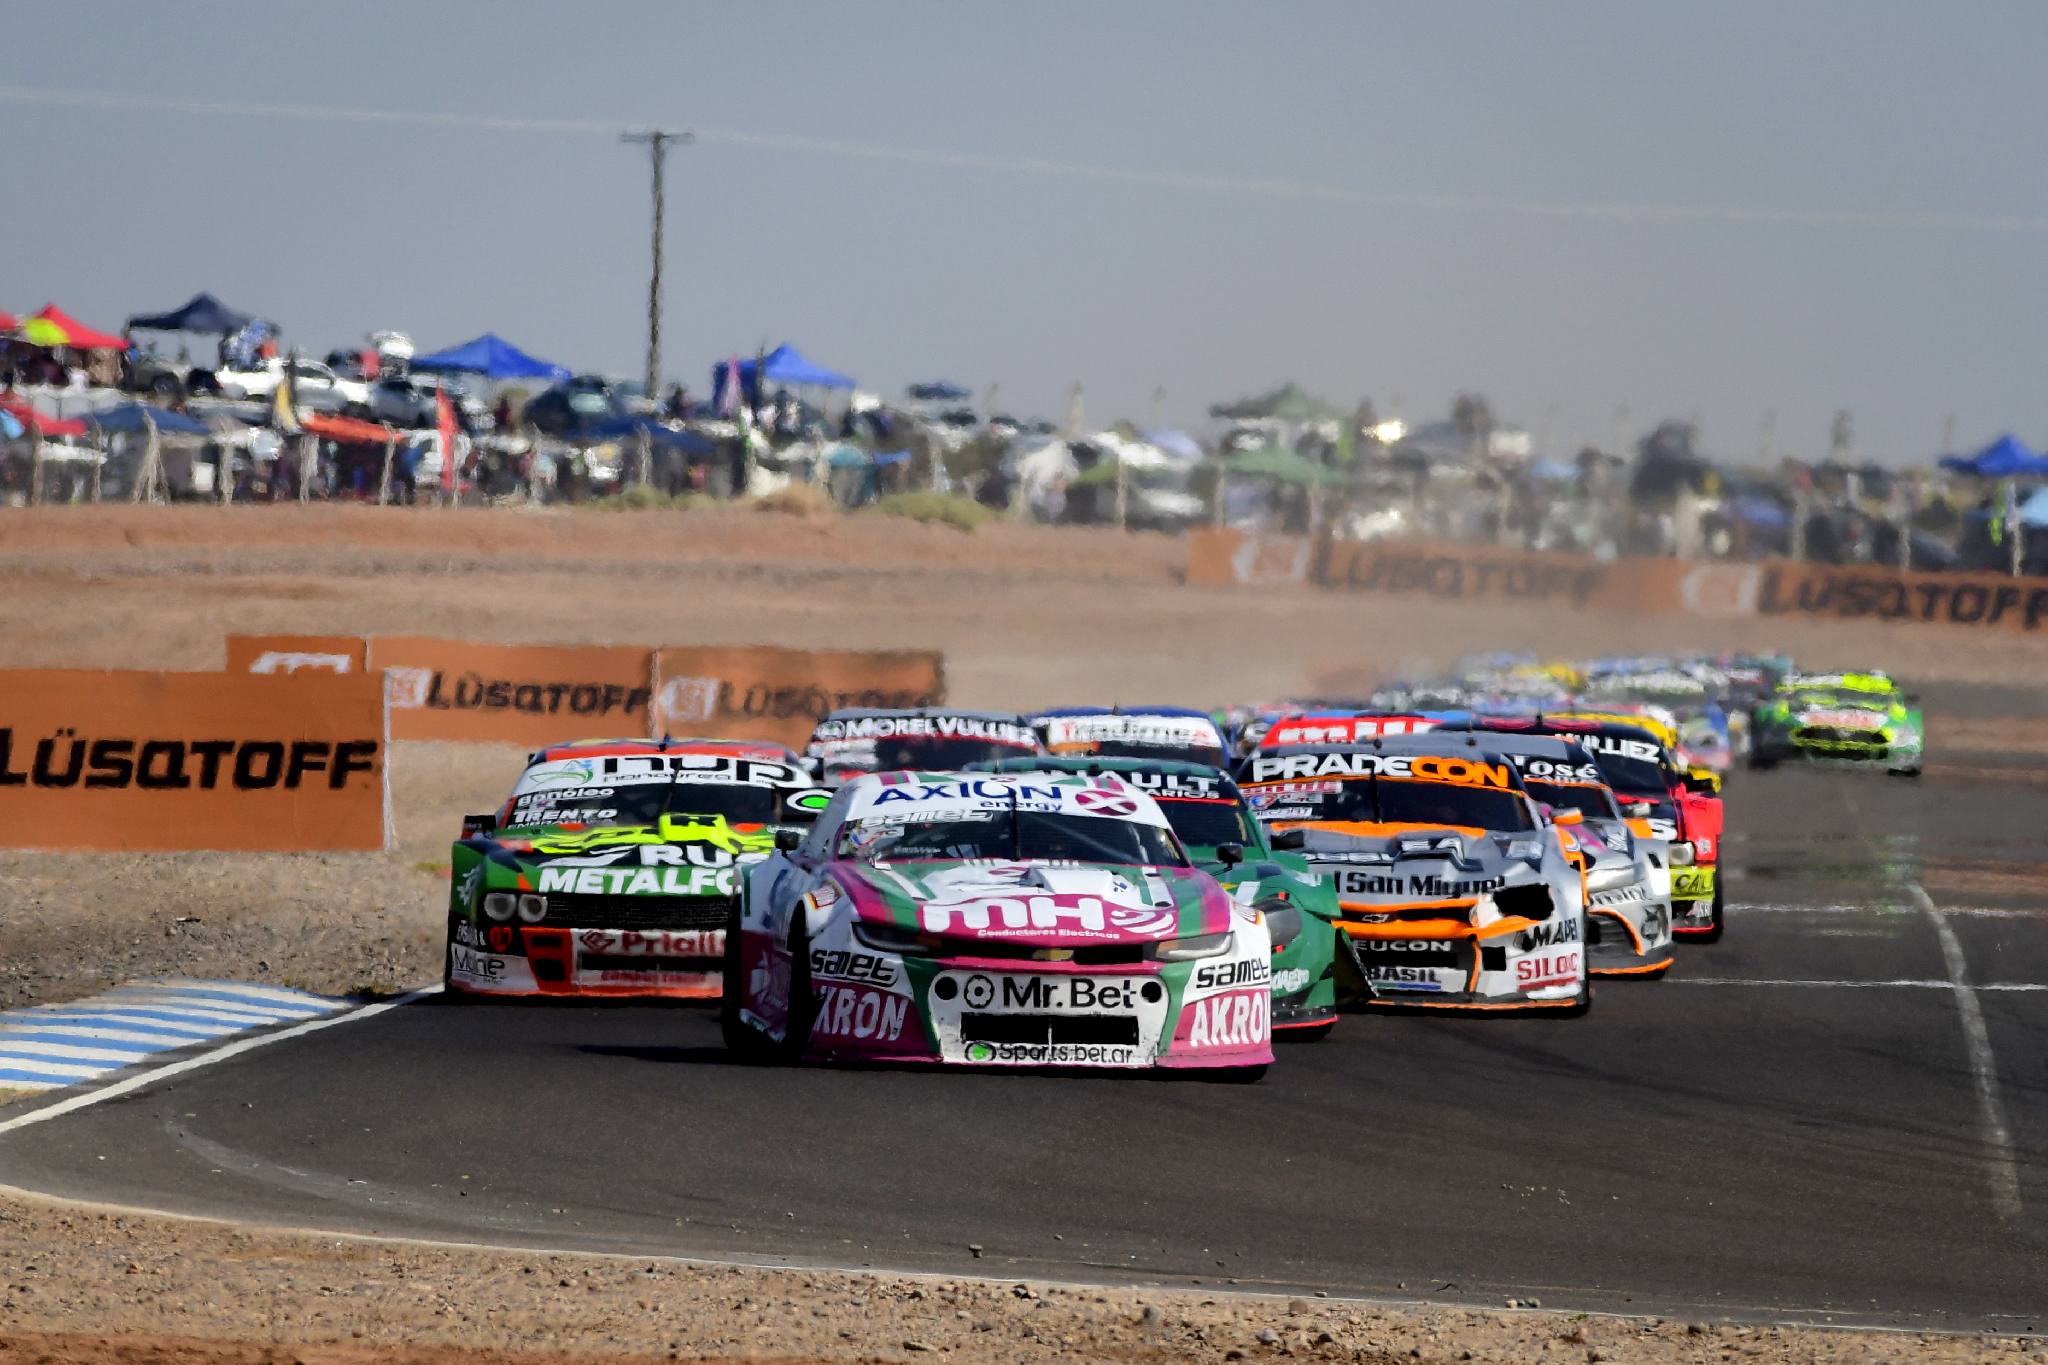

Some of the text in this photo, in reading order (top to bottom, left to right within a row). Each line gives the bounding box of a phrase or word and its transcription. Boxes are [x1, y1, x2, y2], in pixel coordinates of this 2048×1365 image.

[1253, 753, 1508, 788] PRADECON
[872, 781, 1062, 806] AXION
[512, 808, 618, 822] TRENTO
